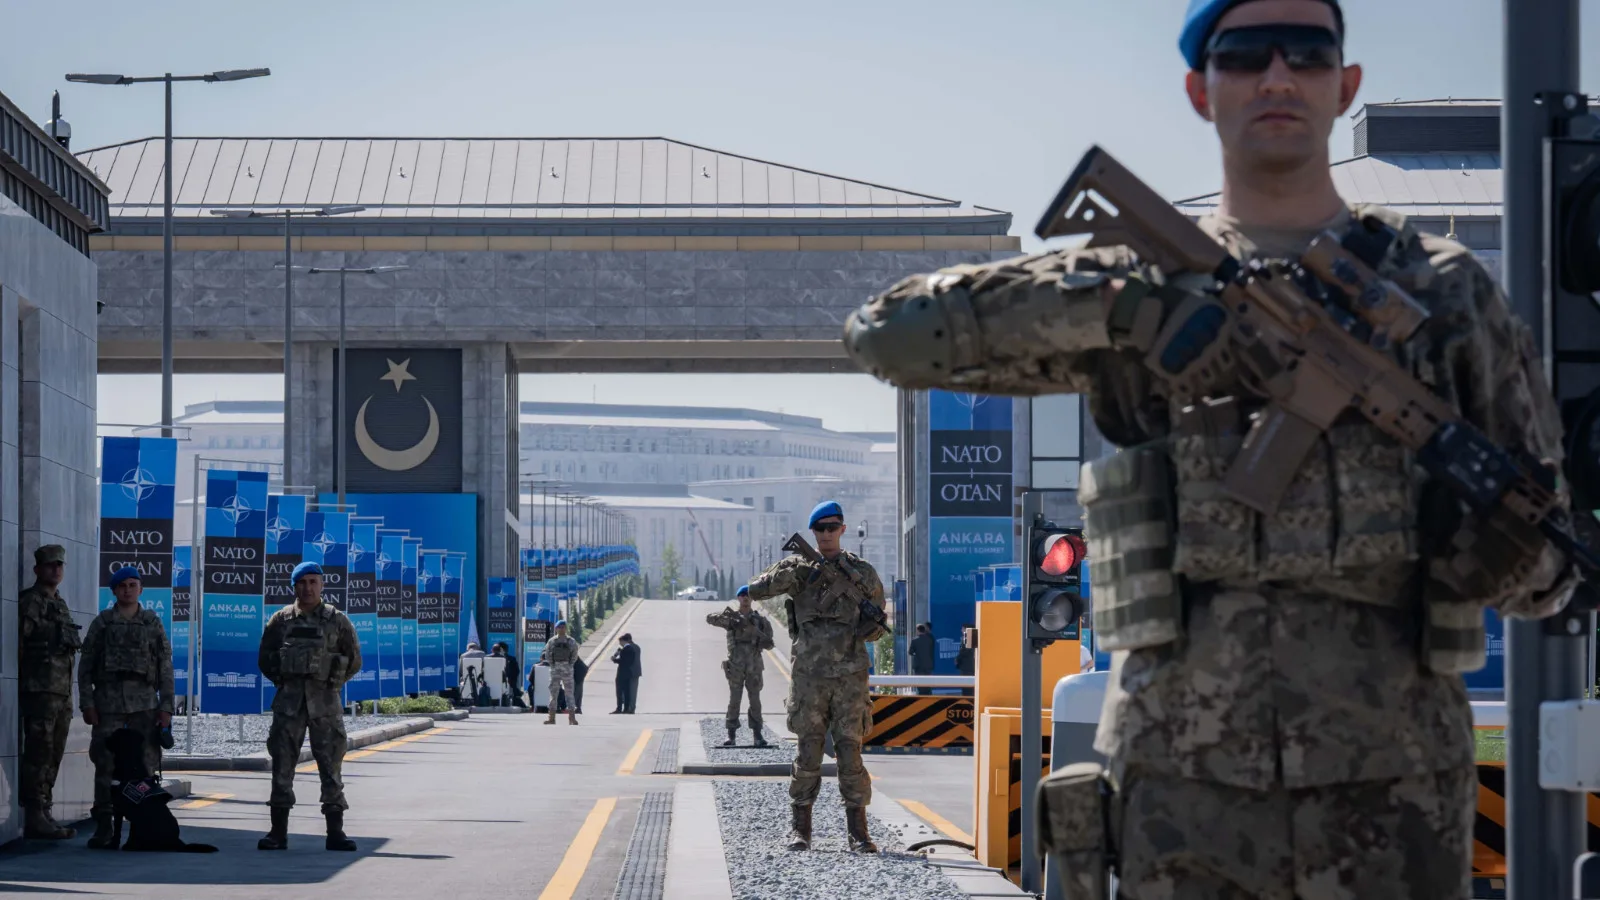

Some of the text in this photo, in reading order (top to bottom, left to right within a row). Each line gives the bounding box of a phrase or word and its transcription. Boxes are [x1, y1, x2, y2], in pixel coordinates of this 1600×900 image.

[941, 445, 1002, 463] NATO
[941, 484, 1003, 501] OTAN
[109, 530, 163, 545] NATO
[938, 532, 1005, 544] ANKARA
[212, 546, 256, 560] NATO
[211, 571, 256, 585] OTAN
[322, 573, 341, 583] TO
[348, 579, 371, 589] ATO
[265, 585, 296, 596] TAN
[376, 586, 397, 595] ATO
[172, 592, 191, 600] ATO
[320, 594, 340, 603] AN
[418, 597, 438, 605] ATO
[349, 597, 371, 607] TAN
[376, 603, 397, 611] TAN
[173, 607, 191, 616] TAN
[208, 603, 257, 613] ANKARA
